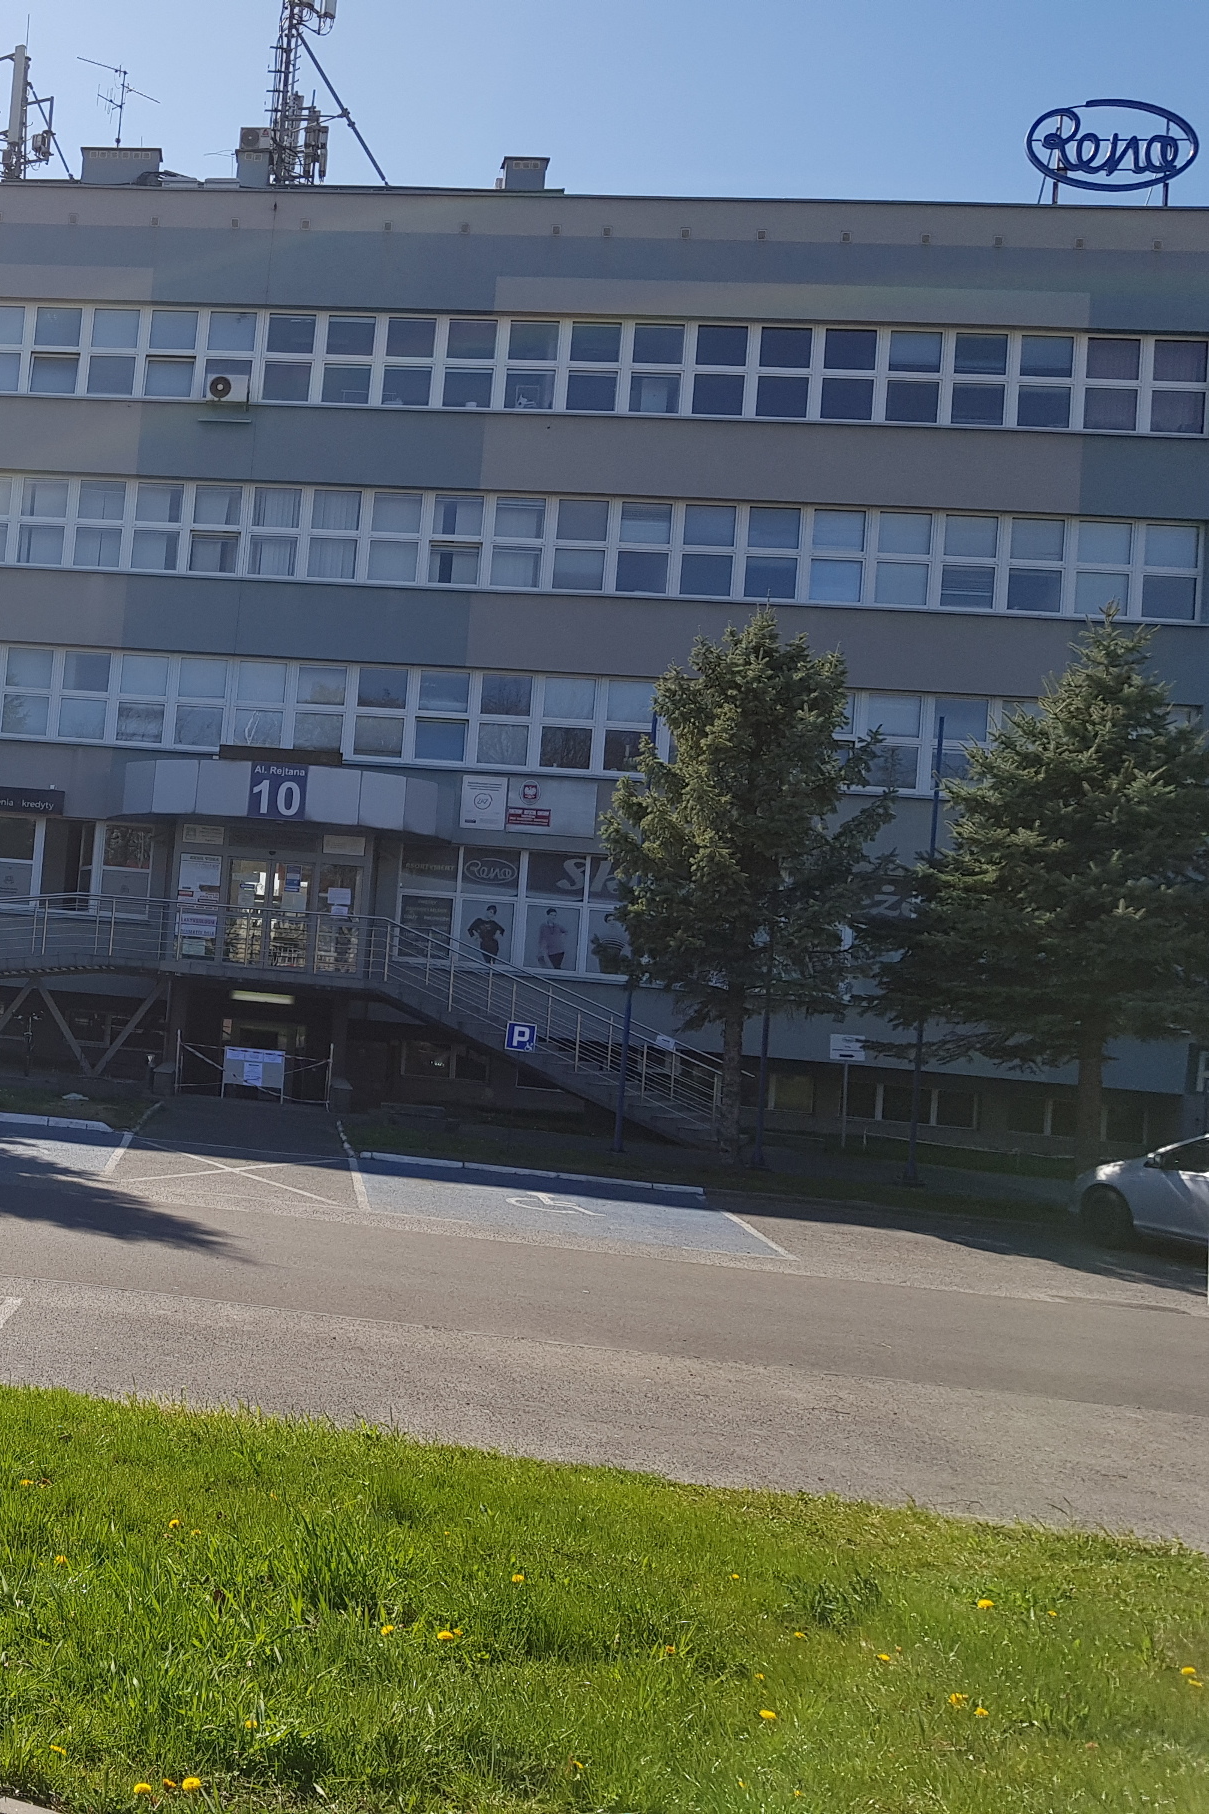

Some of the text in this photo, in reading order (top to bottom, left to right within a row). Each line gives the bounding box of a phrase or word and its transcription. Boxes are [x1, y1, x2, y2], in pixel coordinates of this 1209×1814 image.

[1038, 107, 1181, 178] Reno
[254, 765, 306, 777] Al. Rejtana
[21, 799, 54, 811] kredyty
[253, 779, 301, 817] 10
[468, 860, 513, 880] Reno
[512, 1025, 530, 1047] P
